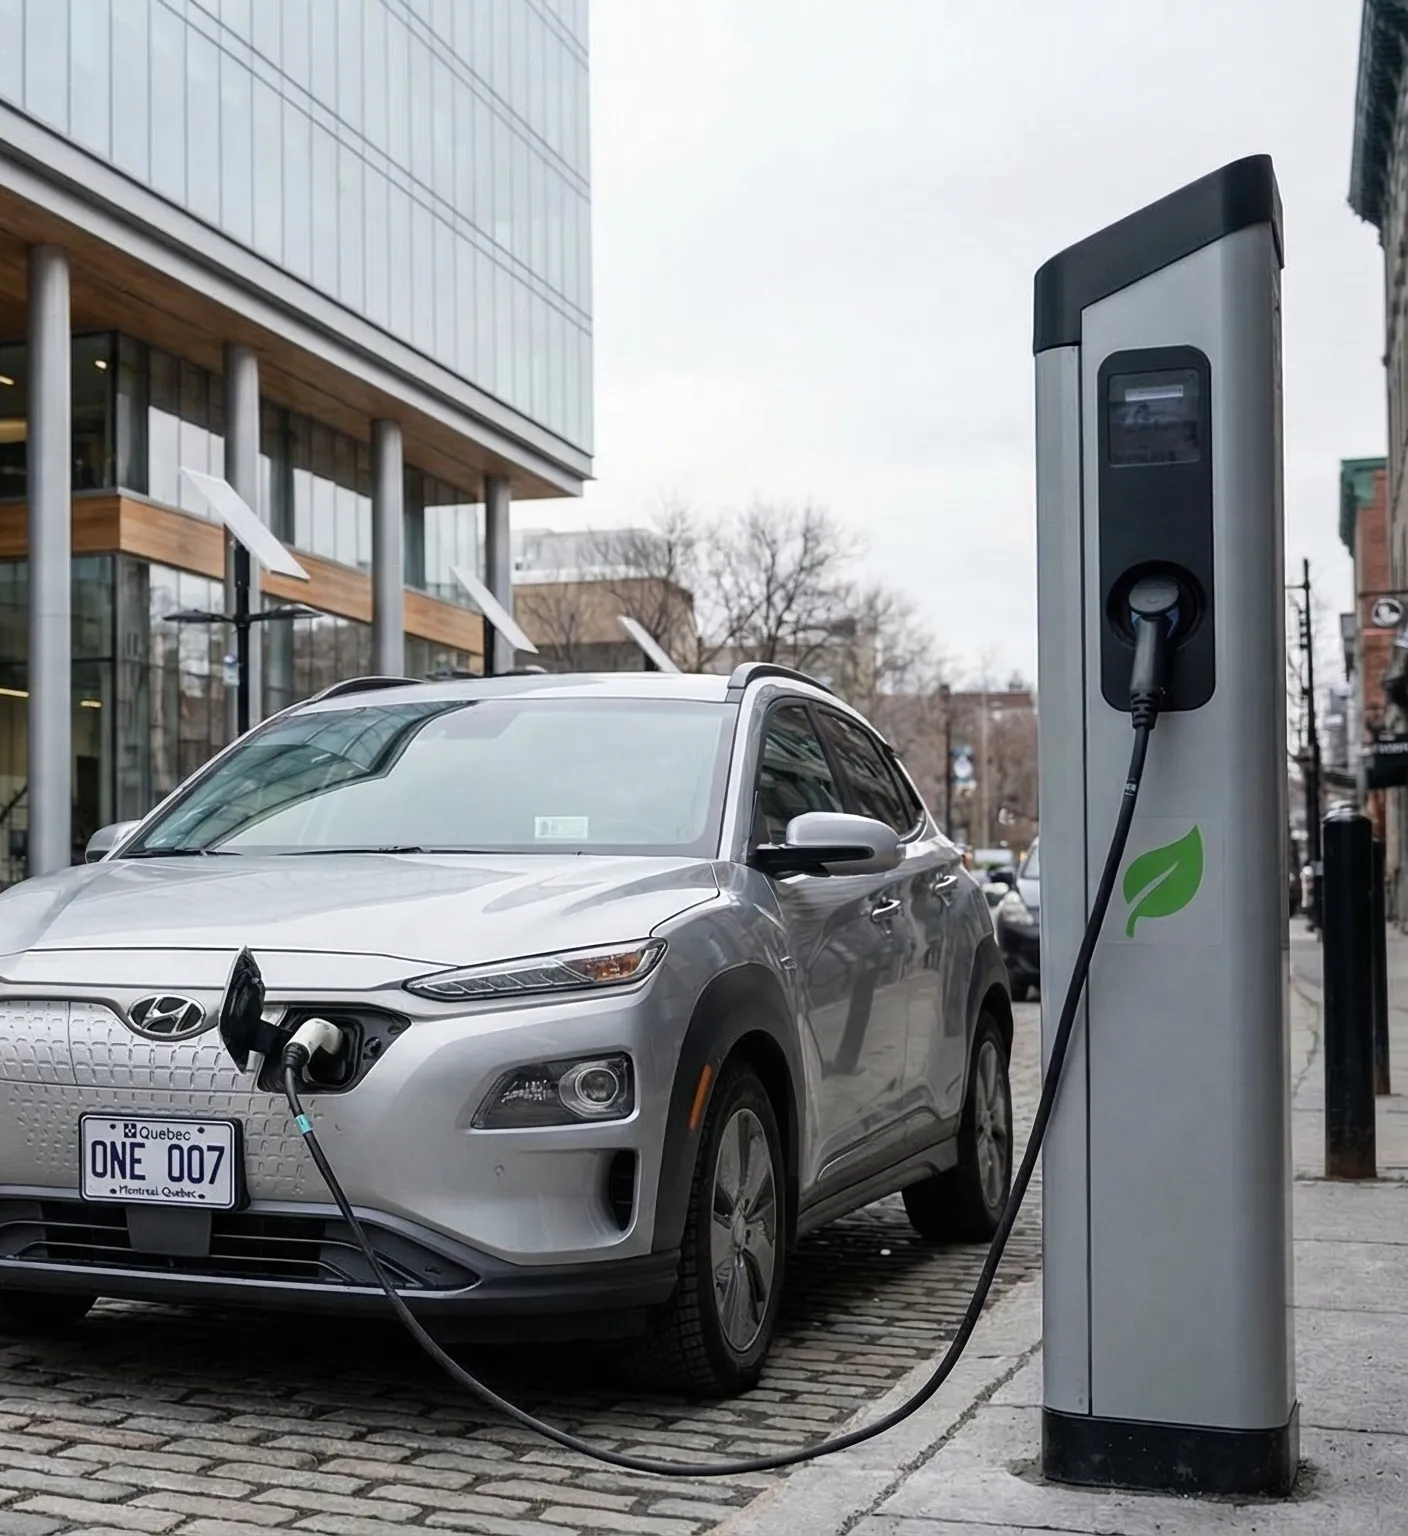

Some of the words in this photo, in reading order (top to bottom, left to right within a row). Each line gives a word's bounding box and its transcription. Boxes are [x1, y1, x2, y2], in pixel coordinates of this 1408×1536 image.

[139, 1126, 191, 1141] Quebec
[91, 1140, 146, 1181] ONE
[167, 1143, 225, 1185] 007
